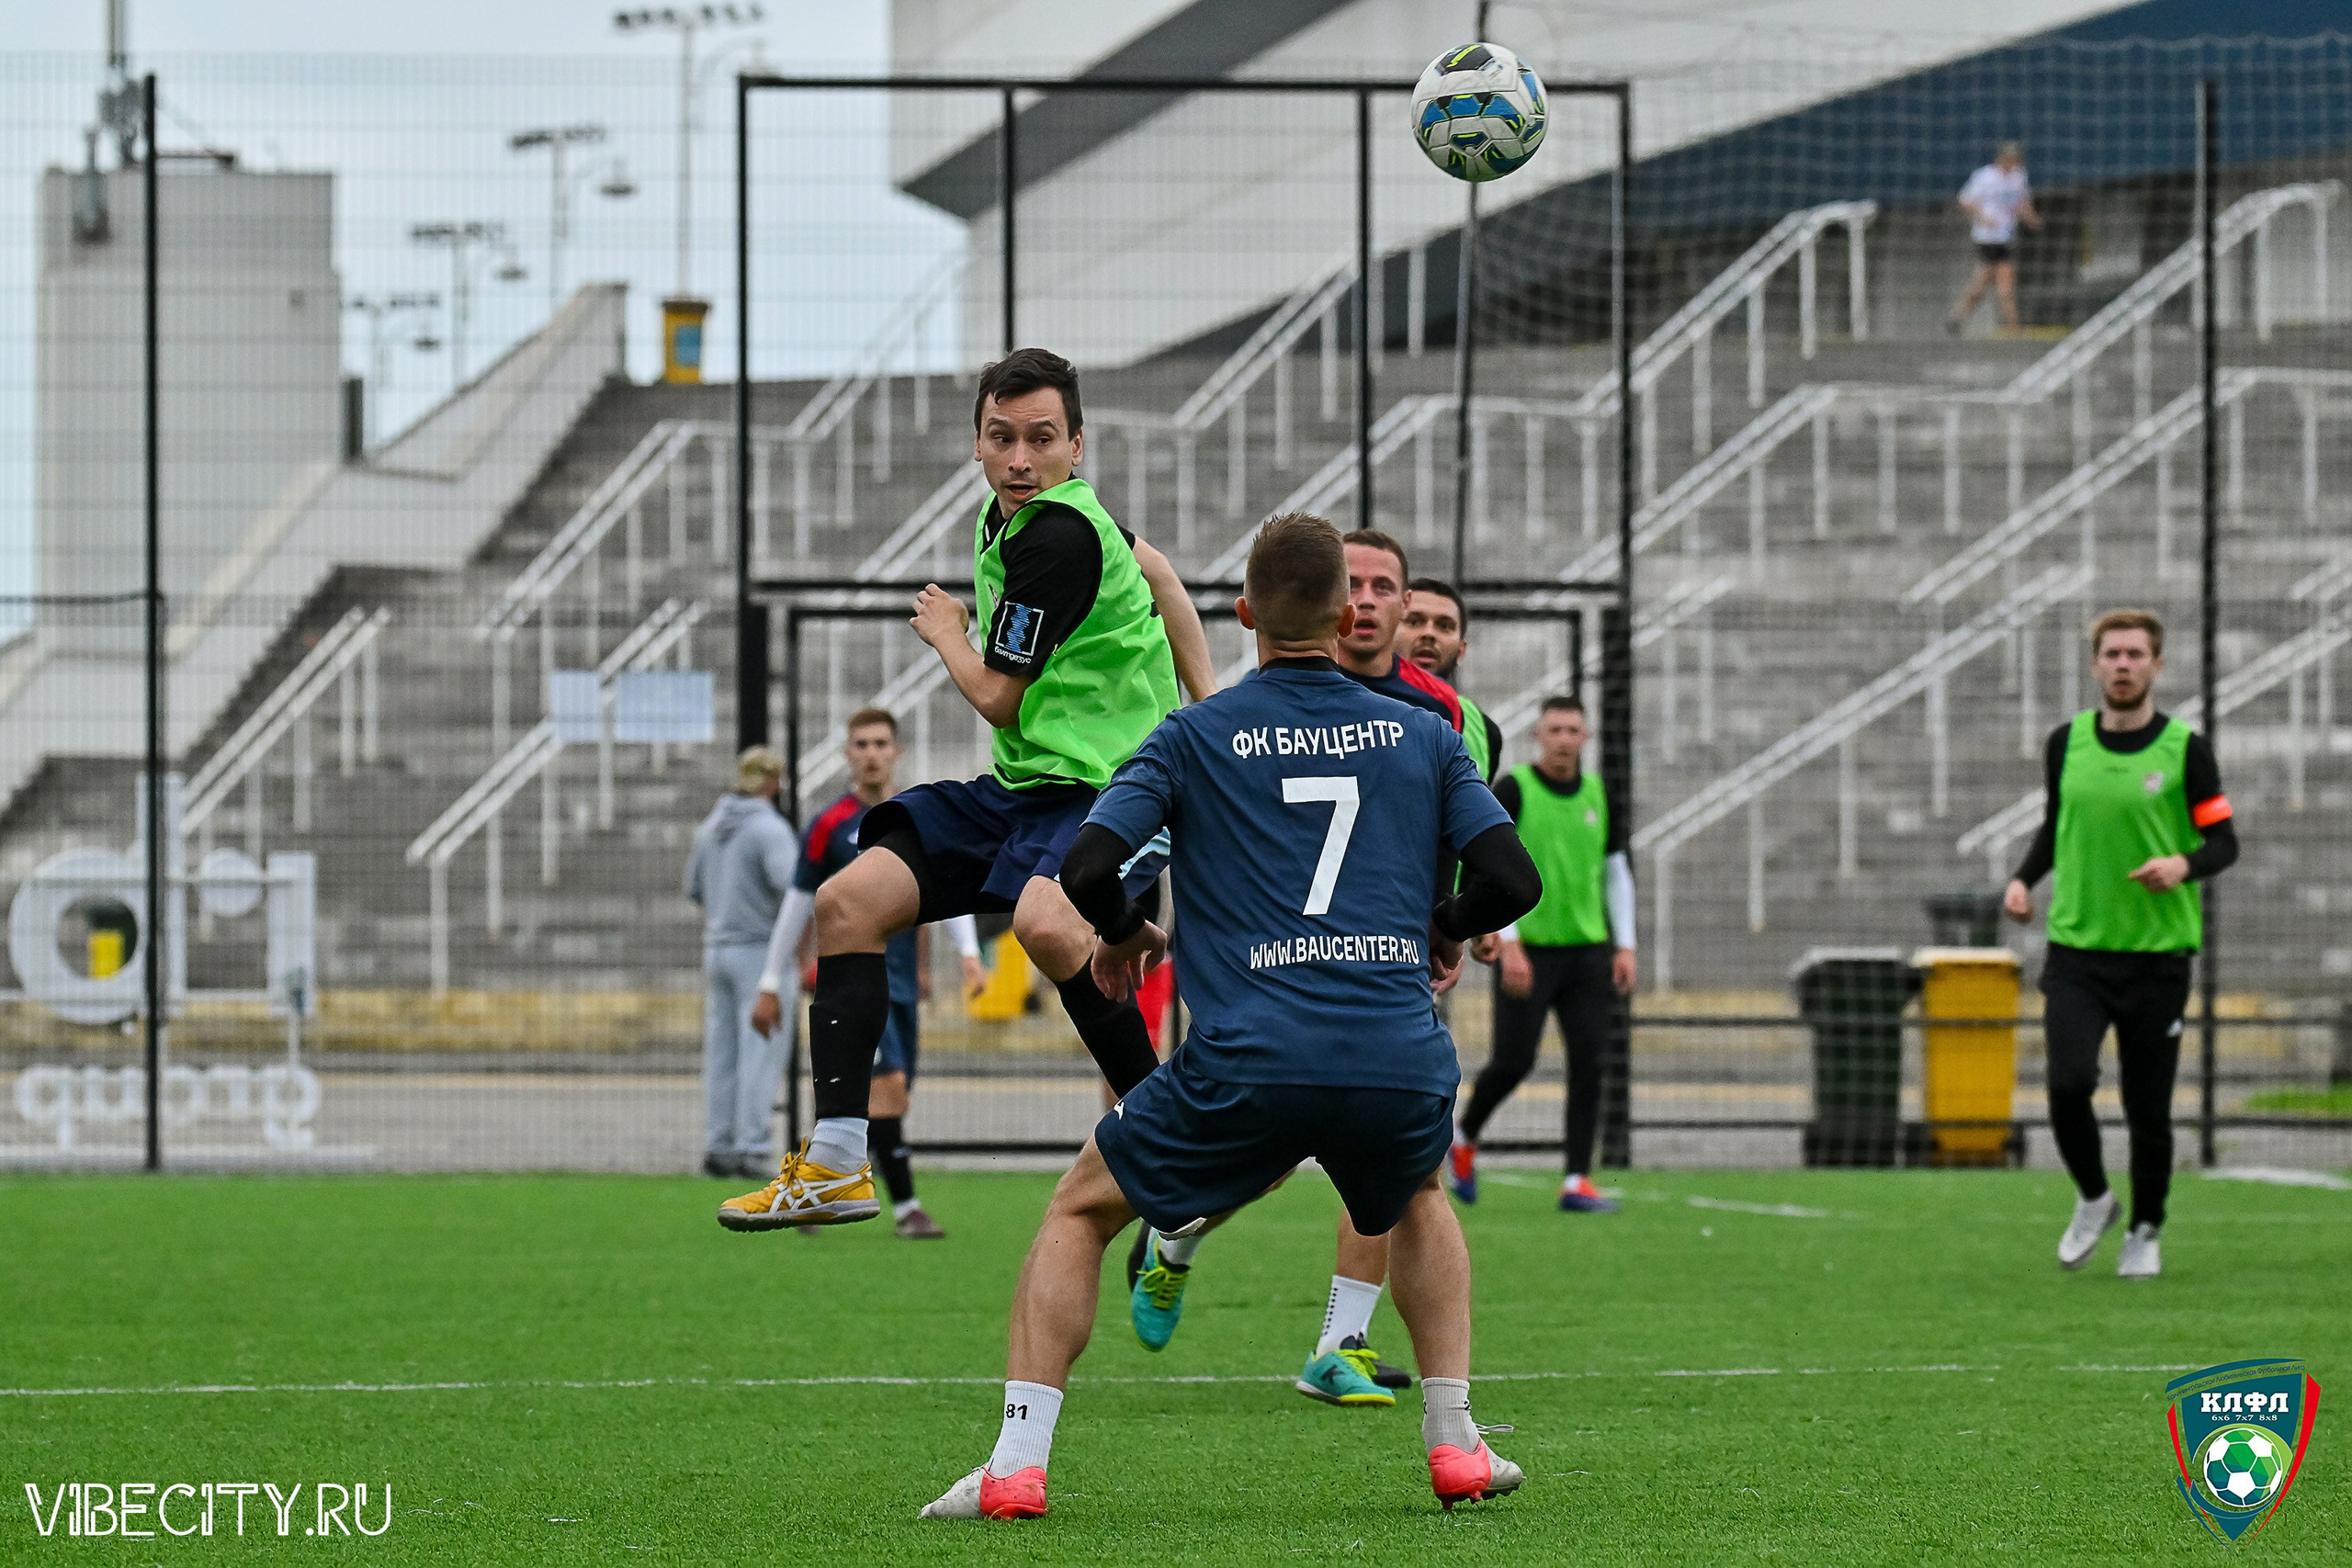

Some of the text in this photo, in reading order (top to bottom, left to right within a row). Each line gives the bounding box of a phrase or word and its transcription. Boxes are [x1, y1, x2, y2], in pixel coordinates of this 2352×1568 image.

[1232, 720, 1404, 760] ФК БАУЦЕНТР
[1282, 776, 1360, 916] 7
[1250, 935, 1419, 970] WWW.BAUCENTER.RU
[1006, 1404, 1028, 1421] 81
